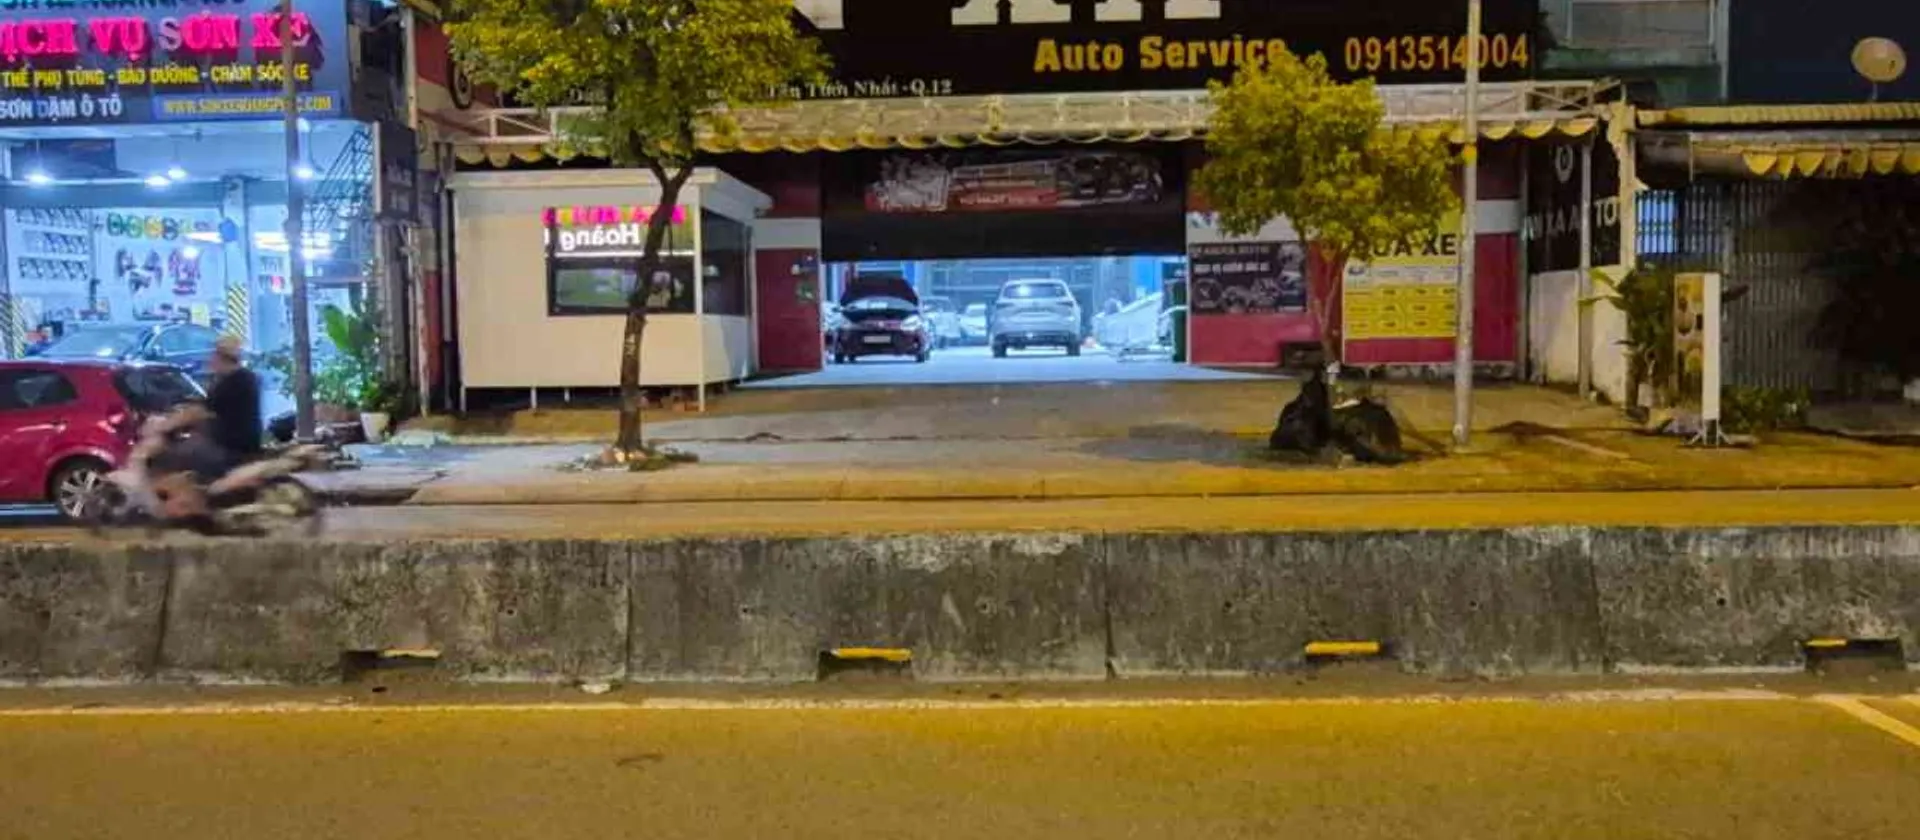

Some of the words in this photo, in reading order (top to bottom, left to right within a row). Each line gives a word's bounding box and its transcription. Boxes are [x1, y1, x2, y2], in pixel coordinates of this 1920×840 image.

[0, 18, 78, 62] ỊCH
[89, 16, 147, 61] VỤ
[160, 10, 240, 51] SƠN
[1033, 38, 1124, 72] Auto
[1140, 33, 1288, 69] Service
[1344, 32, 1529, 71] 0913514004
